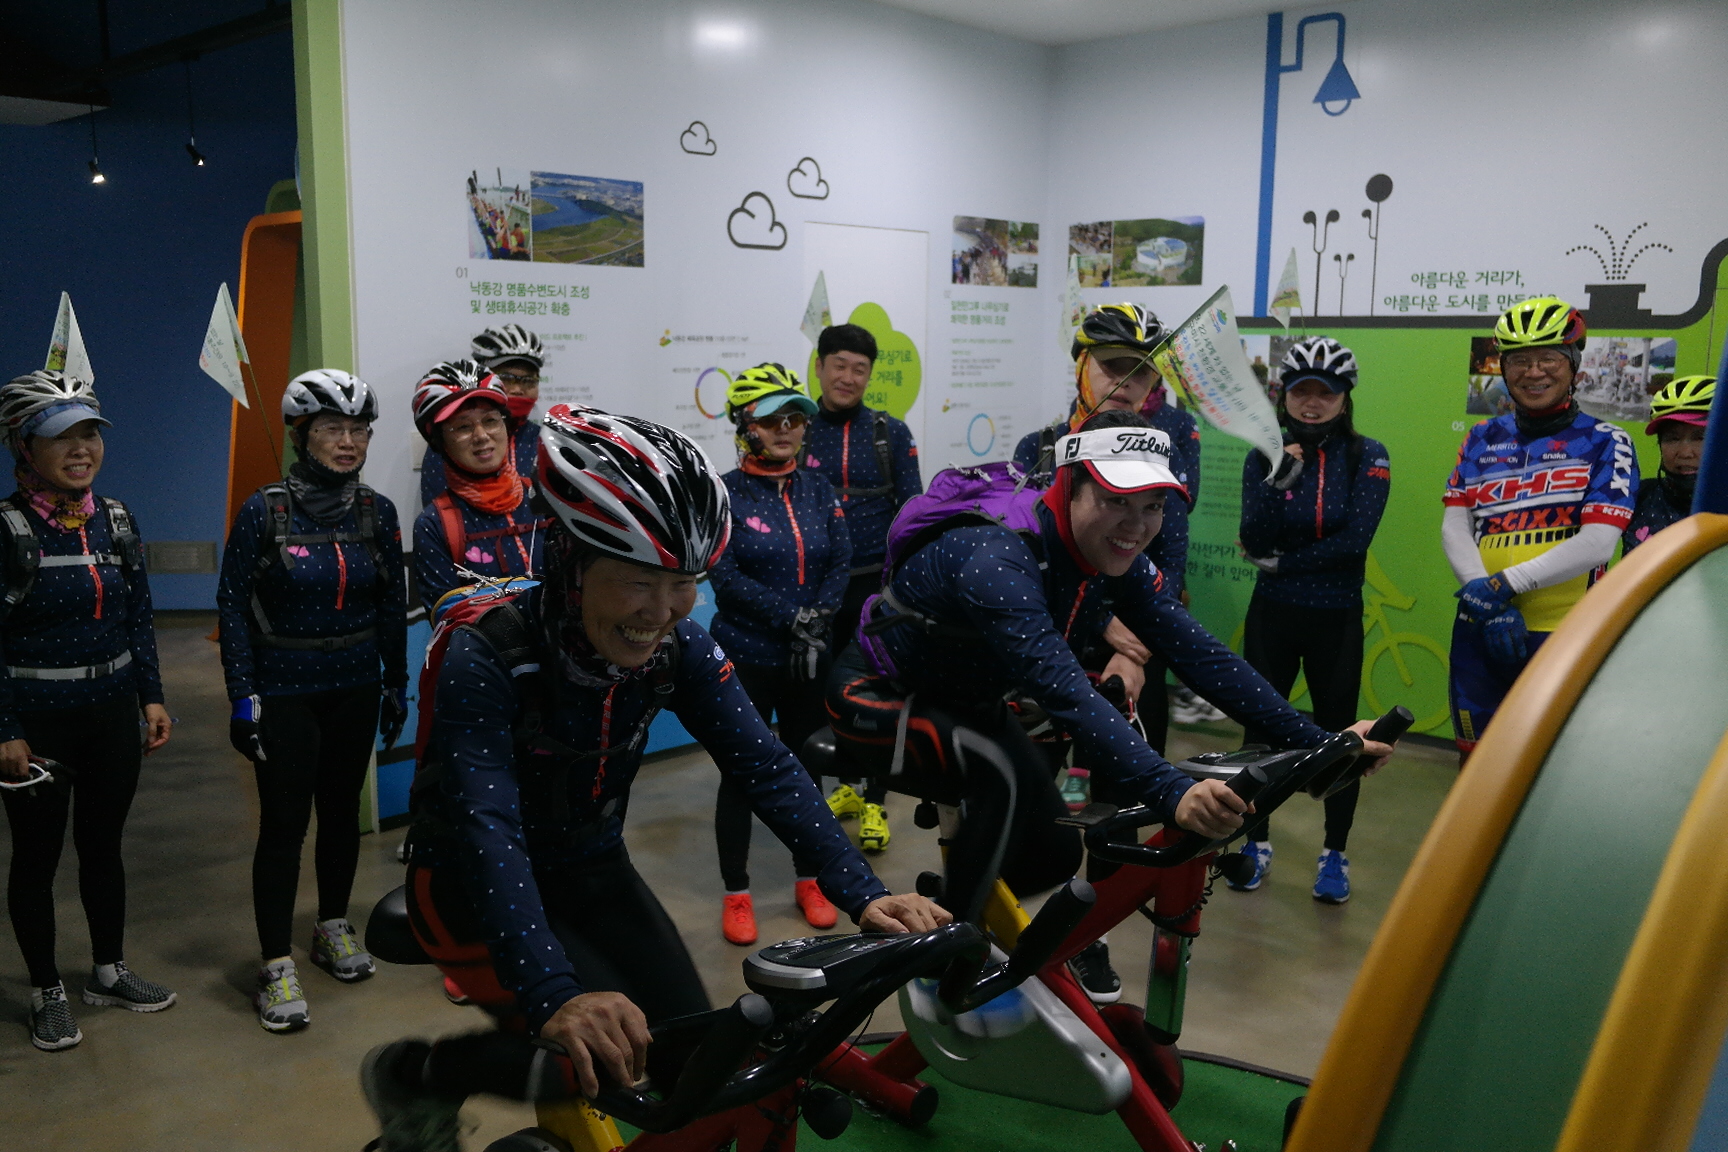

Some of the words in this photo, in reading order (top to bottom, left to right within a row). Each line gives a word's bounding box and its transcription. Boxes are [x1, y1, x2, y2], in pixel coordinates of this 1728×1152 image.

[456, 266, 469, 278] 01
[1411, 271, 1469, 289] 아름다운
[1475, 270, 1525, 288] 거리가,
[470, 281, 503, 296] 낙동강
[506, 284, 567, 298] 명품수변도시
[570, 286, 590, 299] 조성
[470, 299, 481, 314] 및
[485, 301, 548, 315] 생태휴식공간
[551, 302, 570, 316] 확충
[1383, 295, 1440, 312] 아름다운
[1445, 294, 1491, 312] 도시를
[877, 370, 903, 386] 거리를
[1452, 421, 1465, 431] 05
[1065, 437, 1081, 460] FJ
[1542, 452, 1567, 460] snake
[1465, 464, 1592, 508] KHS
[1229, 567, 1257, 581] 있어
